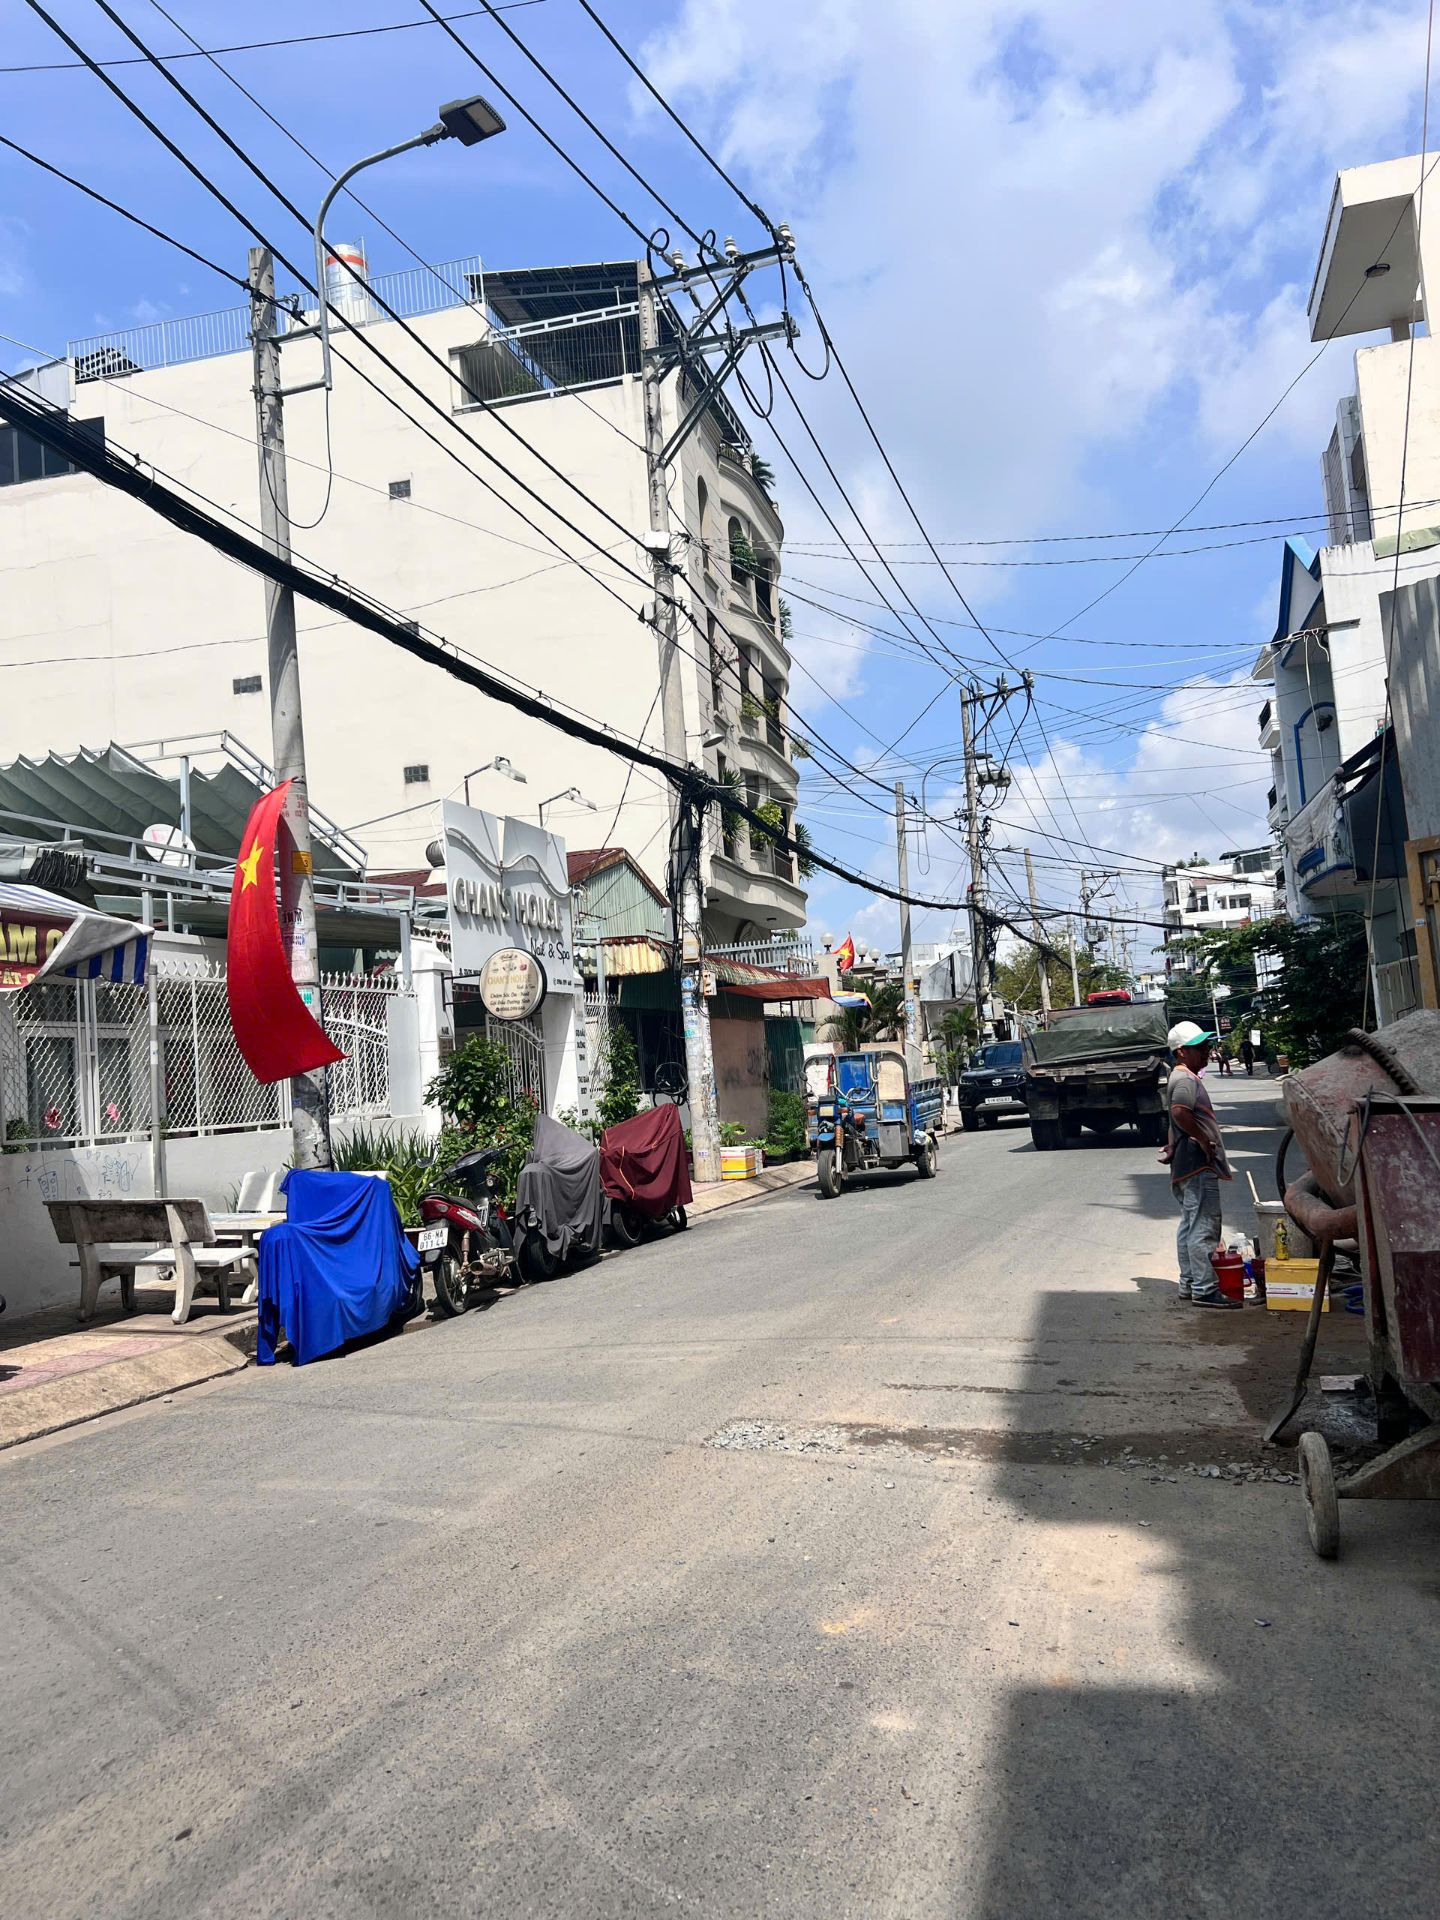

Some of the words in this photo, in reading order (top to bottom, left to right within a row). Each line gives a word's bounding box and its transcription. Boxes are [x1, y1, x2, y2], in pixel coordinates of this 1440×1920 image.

[515, 891, 563, 932] HOUSE
[530, 936, 546, 957] Nail
[548, 943, 555, 959] &
[556, 941, 571, 965] Spa
